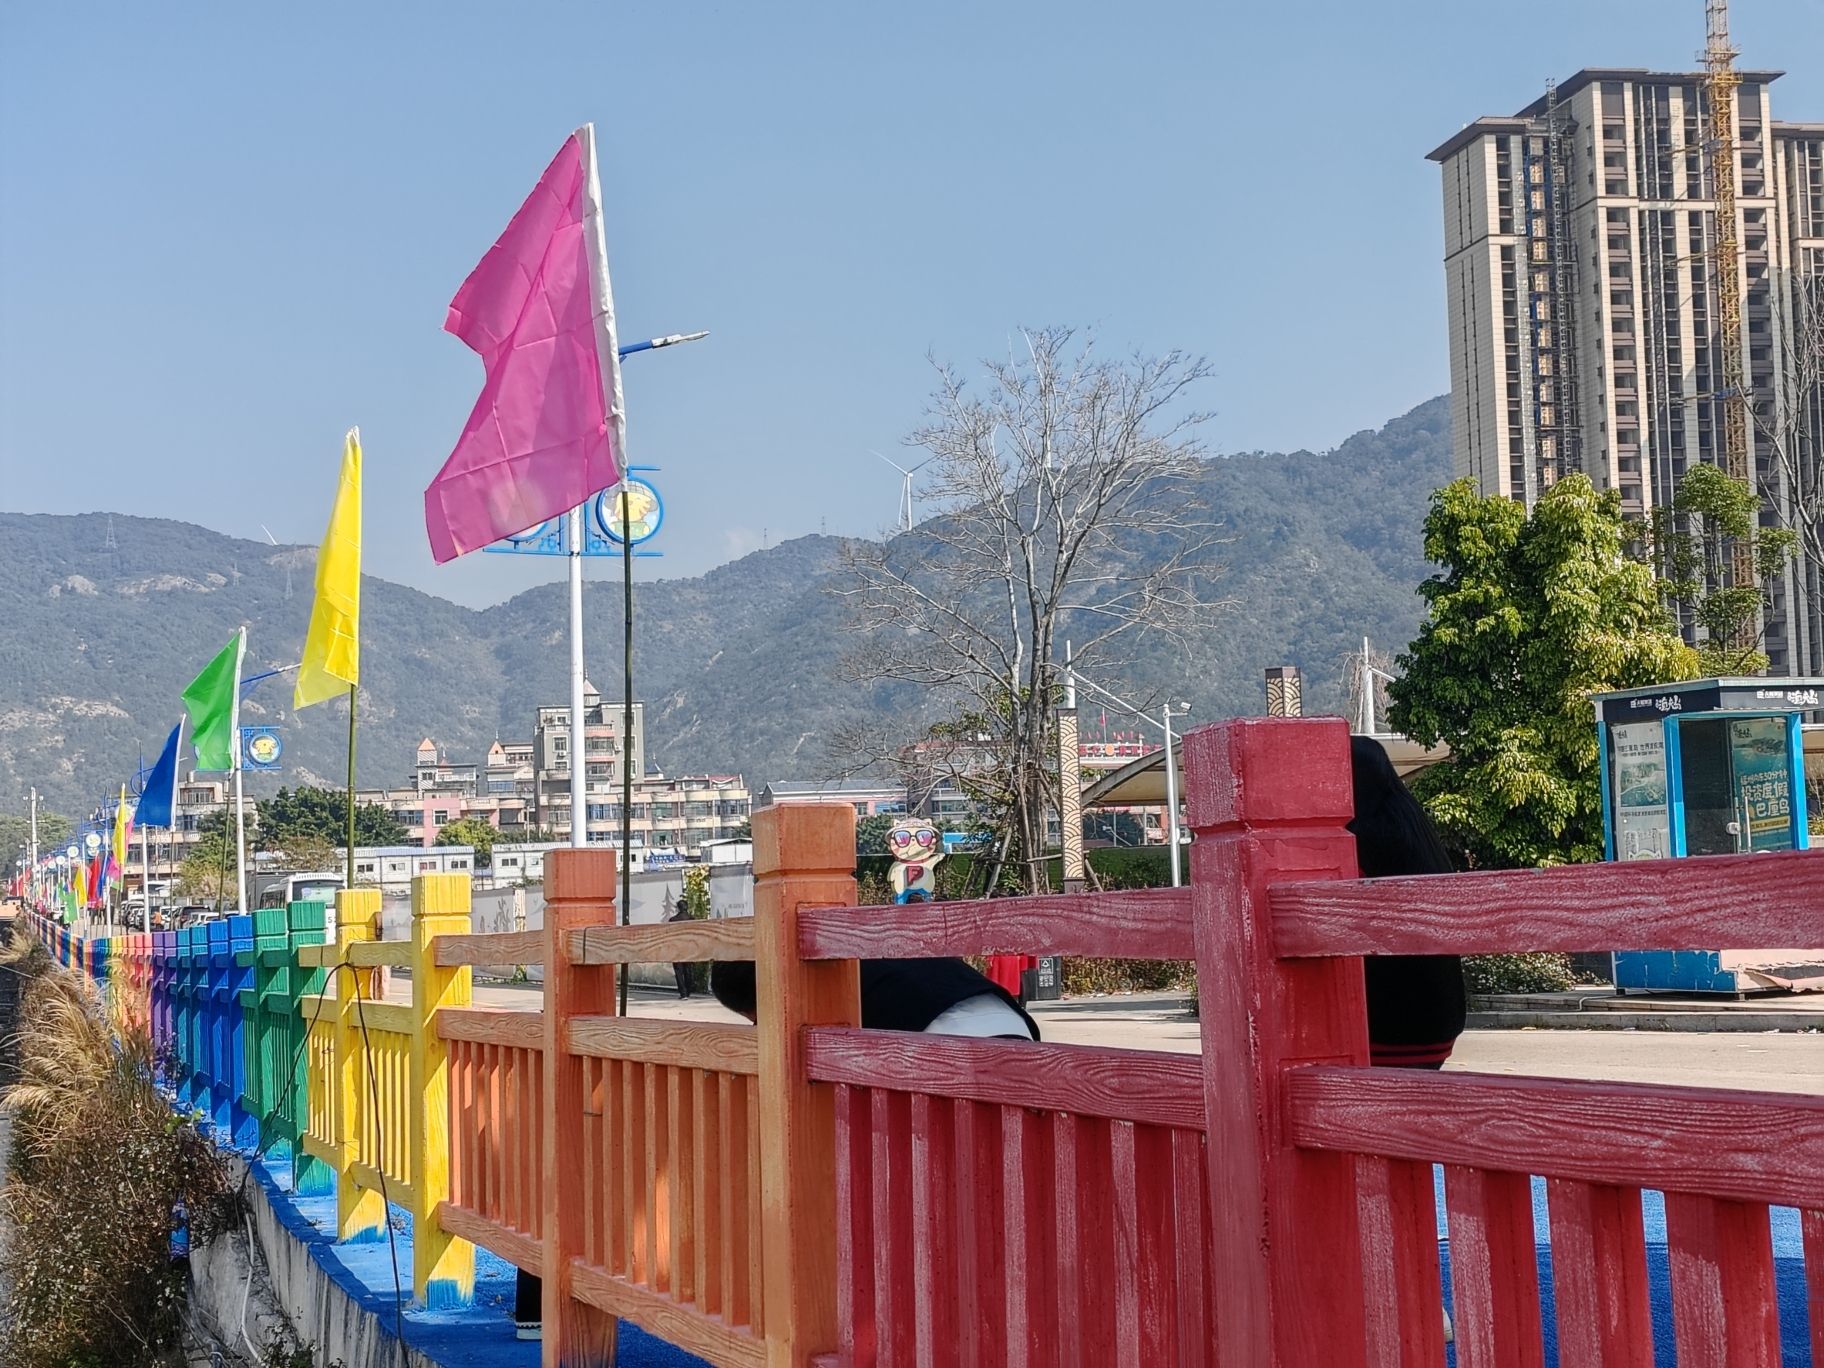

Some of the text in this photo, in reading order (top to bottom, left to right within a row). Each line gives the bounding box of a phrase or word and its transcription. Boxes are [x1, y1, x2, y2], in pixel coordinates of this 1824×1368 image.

[1741, 781, 1789, 802] 投资度假
[1756, 797, 1790, 817] 巴厘岛
[906, 866, 924, 887] P
